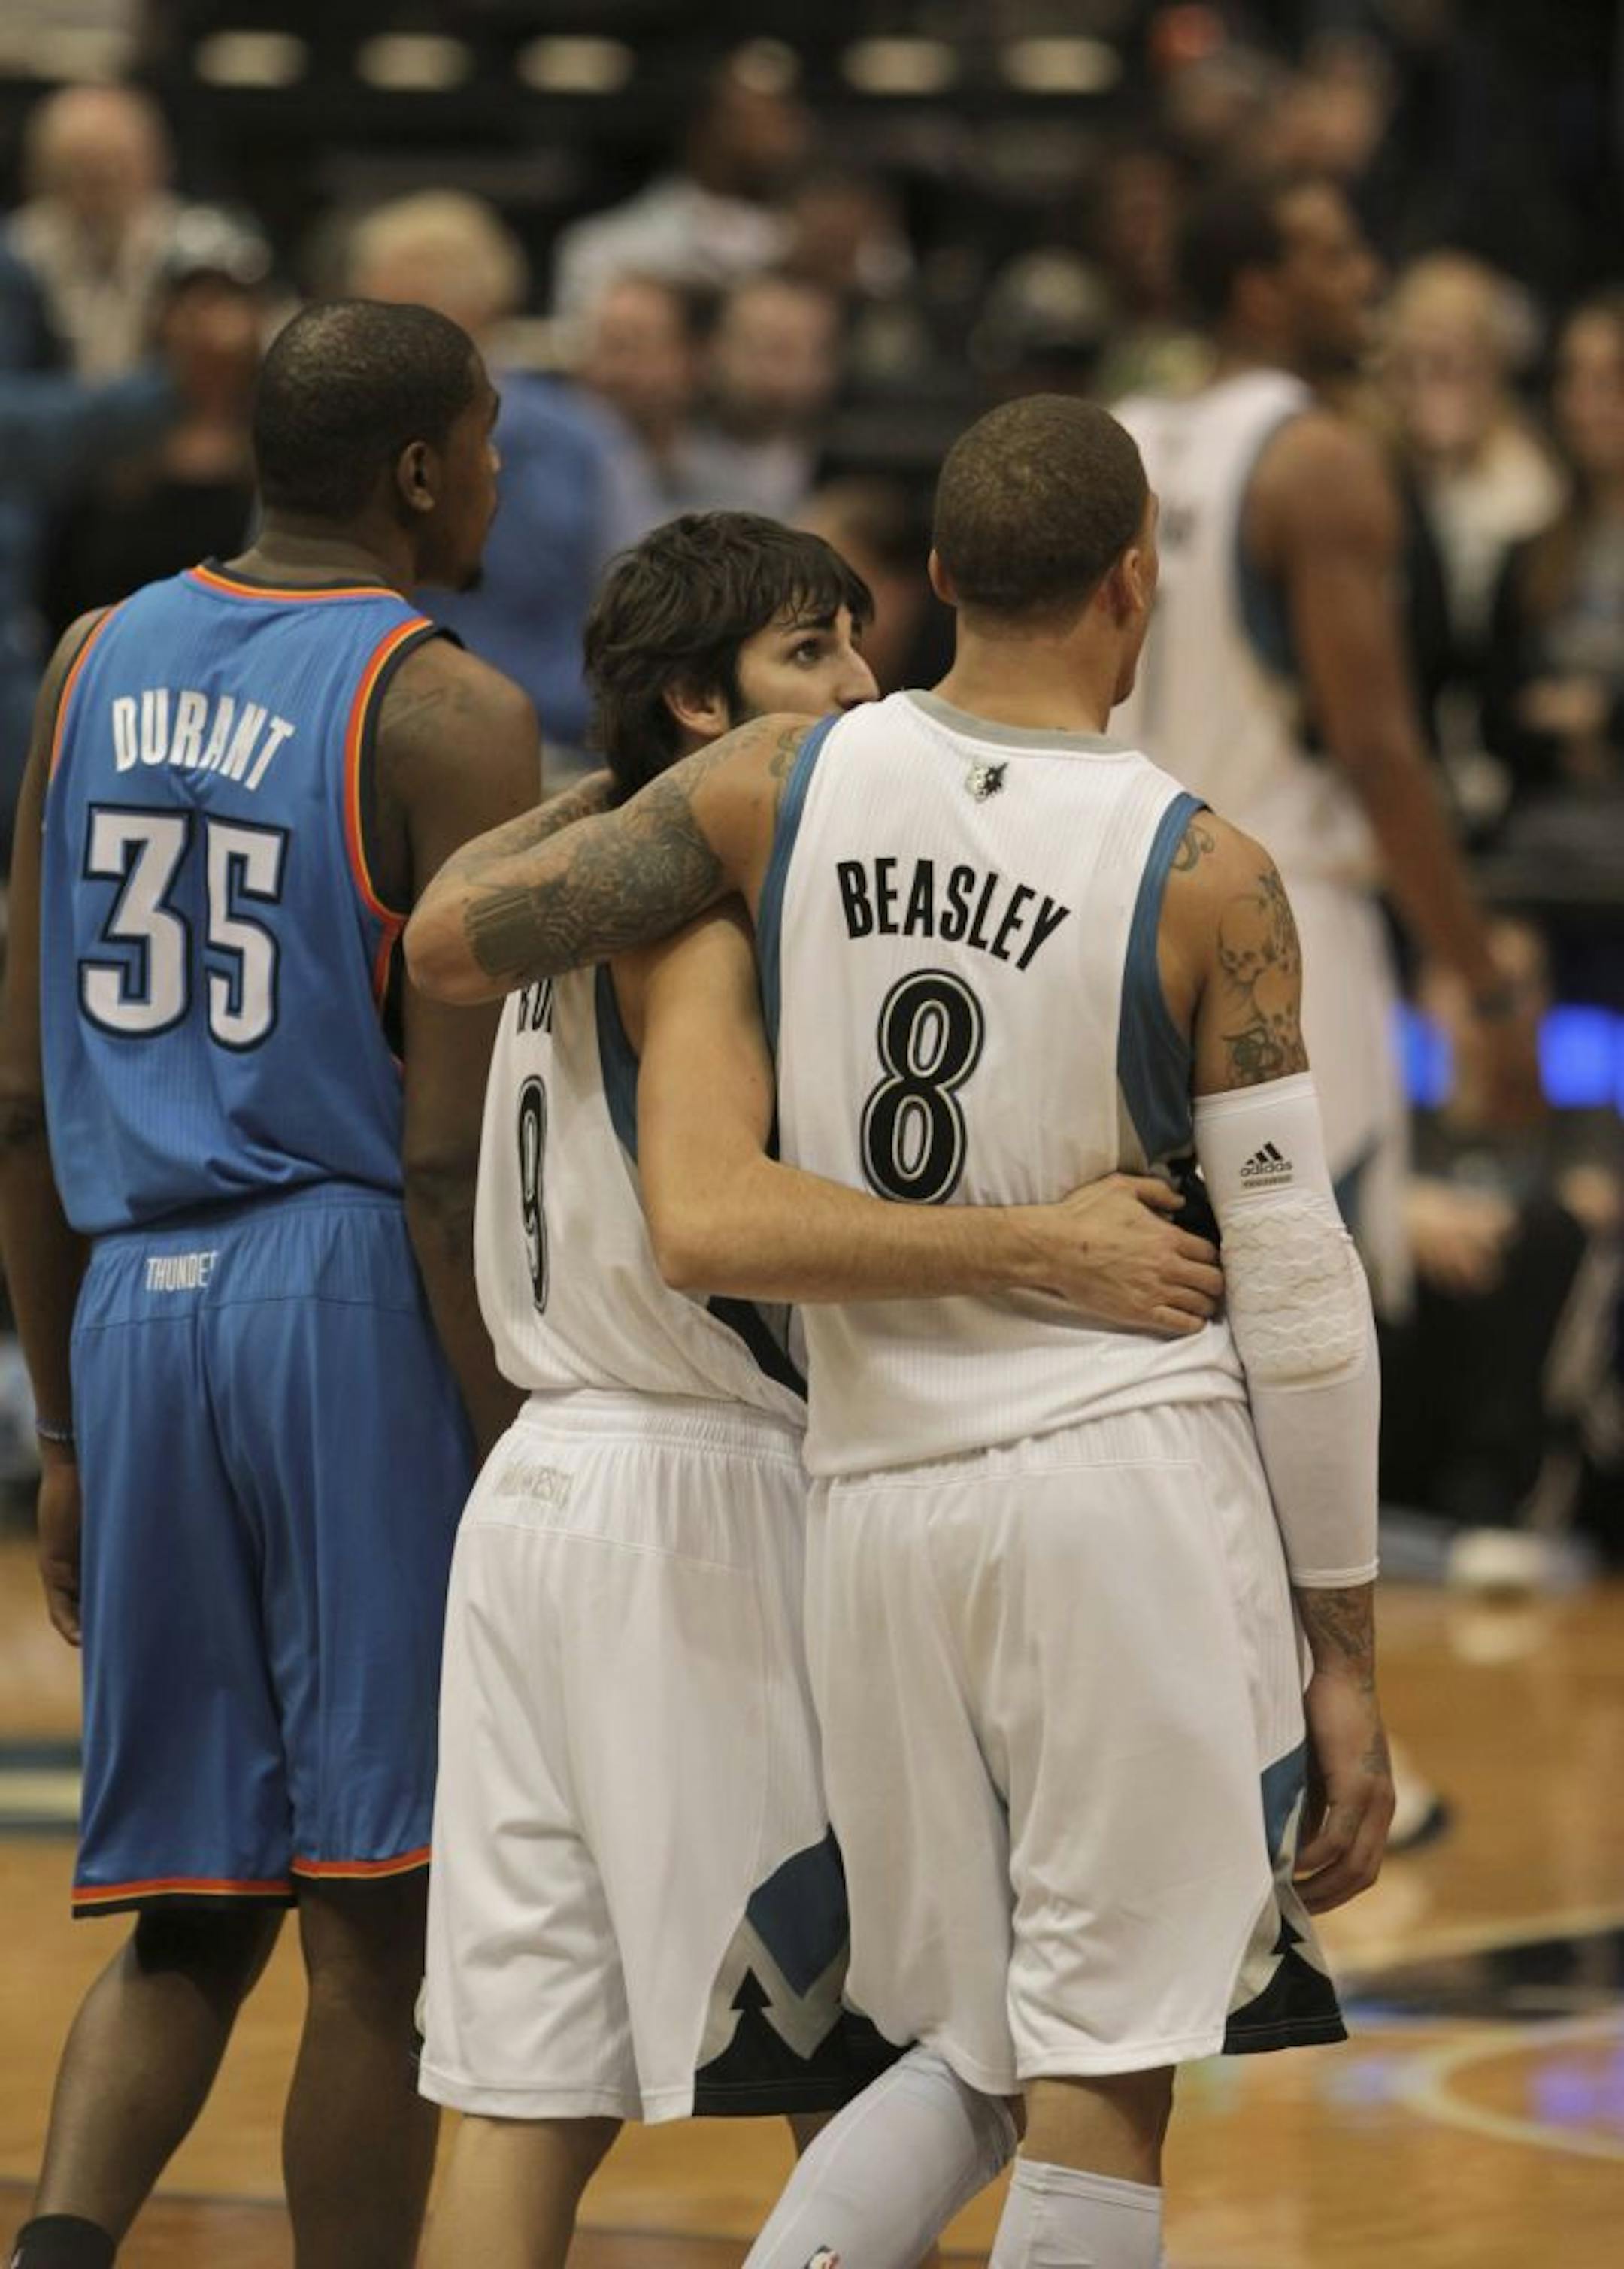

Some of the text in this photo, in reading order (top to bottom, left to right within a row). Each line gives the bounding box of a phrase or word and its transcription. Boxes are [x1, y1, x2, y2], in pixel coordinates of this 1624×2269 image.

[112, 688, 295, 790] DURANT
[78, 802, 291, 1053] 35
[837, 857, 1071, 971] BEASLEY
[861, 968, 985, 1204] 8
[1240, 1161, 1293, 1177] adidas
[518, 1074, 550, 1315] 9
